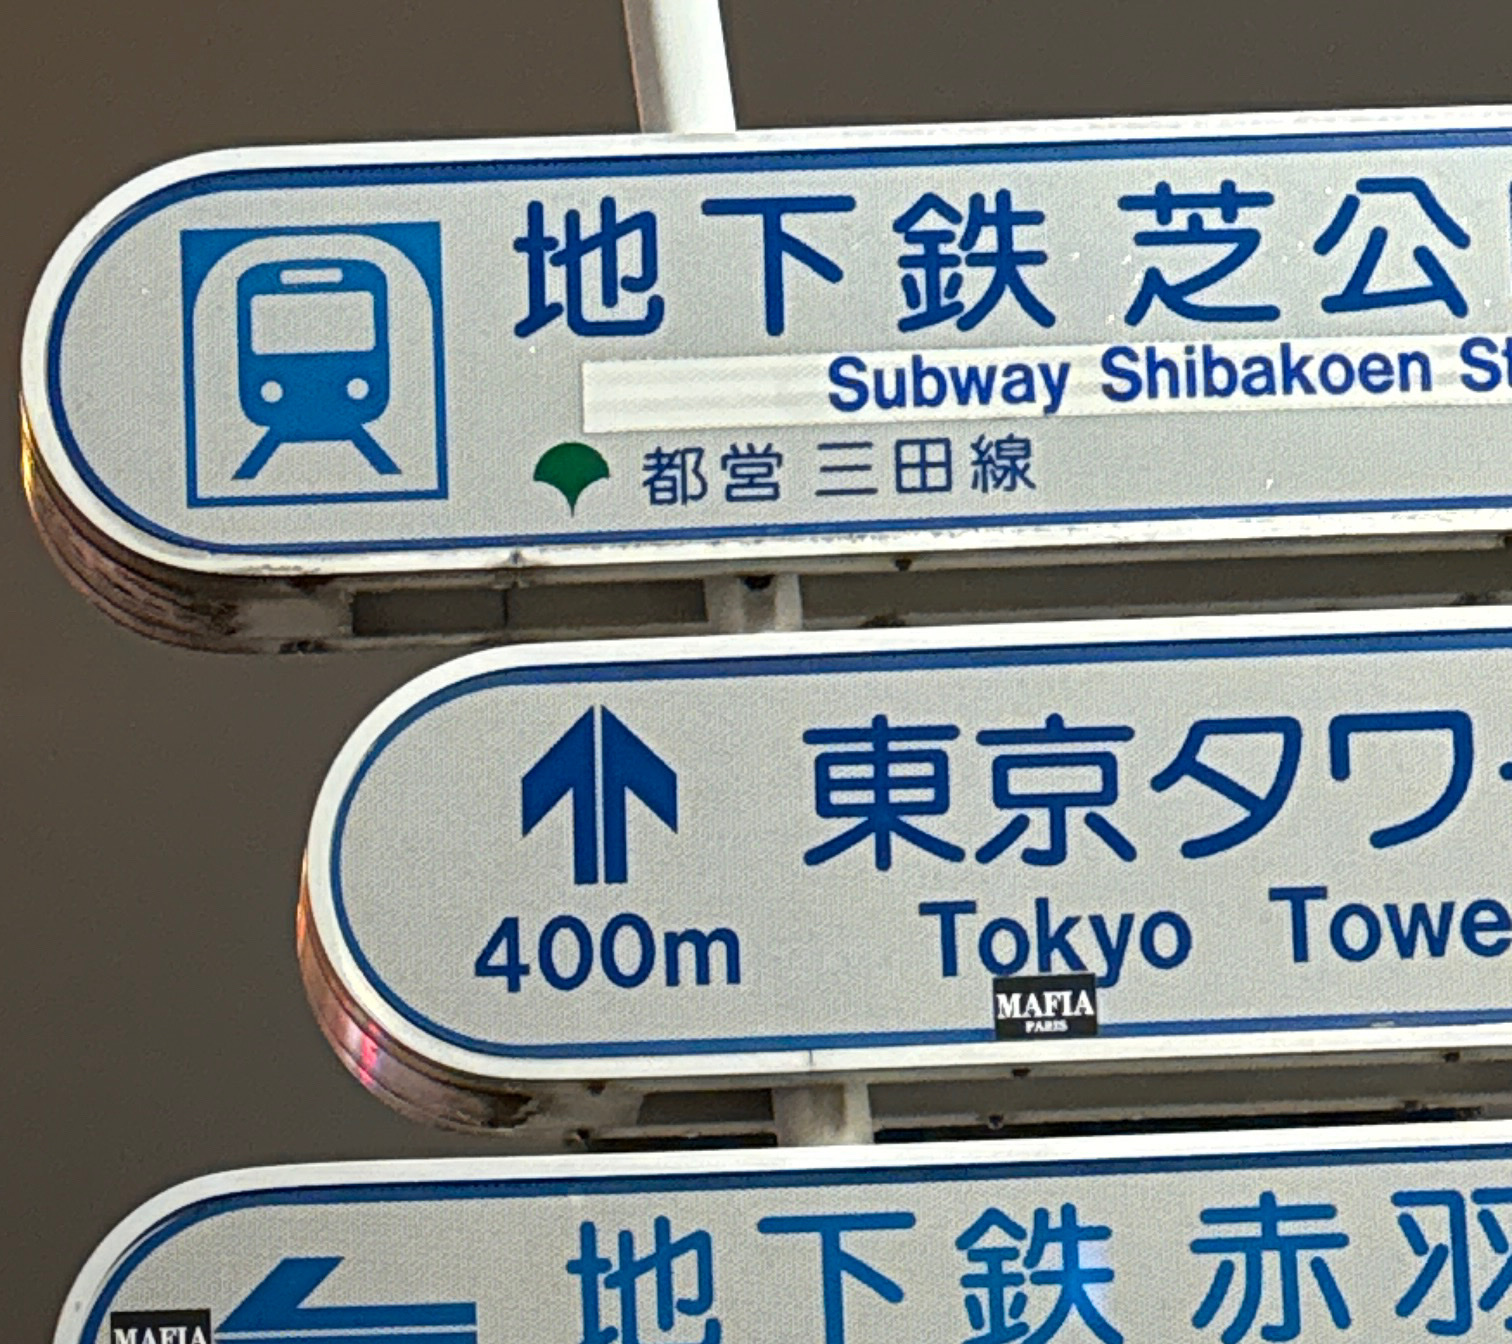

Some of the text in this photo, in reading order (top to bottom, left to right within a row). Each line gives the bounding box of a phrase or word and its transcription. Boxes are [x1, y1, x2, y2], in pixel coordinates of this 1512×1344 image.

[1117, 177, 1512, 327] 芝公
[829, 354, 1070, 415] Subway
[1100, 342, 1432, 401] Shibakoen
[802, 710, 1512, 872] 東京タワ
[474, 913, 741, 993] 400m
[918, 897, 1192, 989] Tokyo
[996, 989, 1095, 1019] MAFIA
[1025, 1020, 1068, 1033] PARIS
